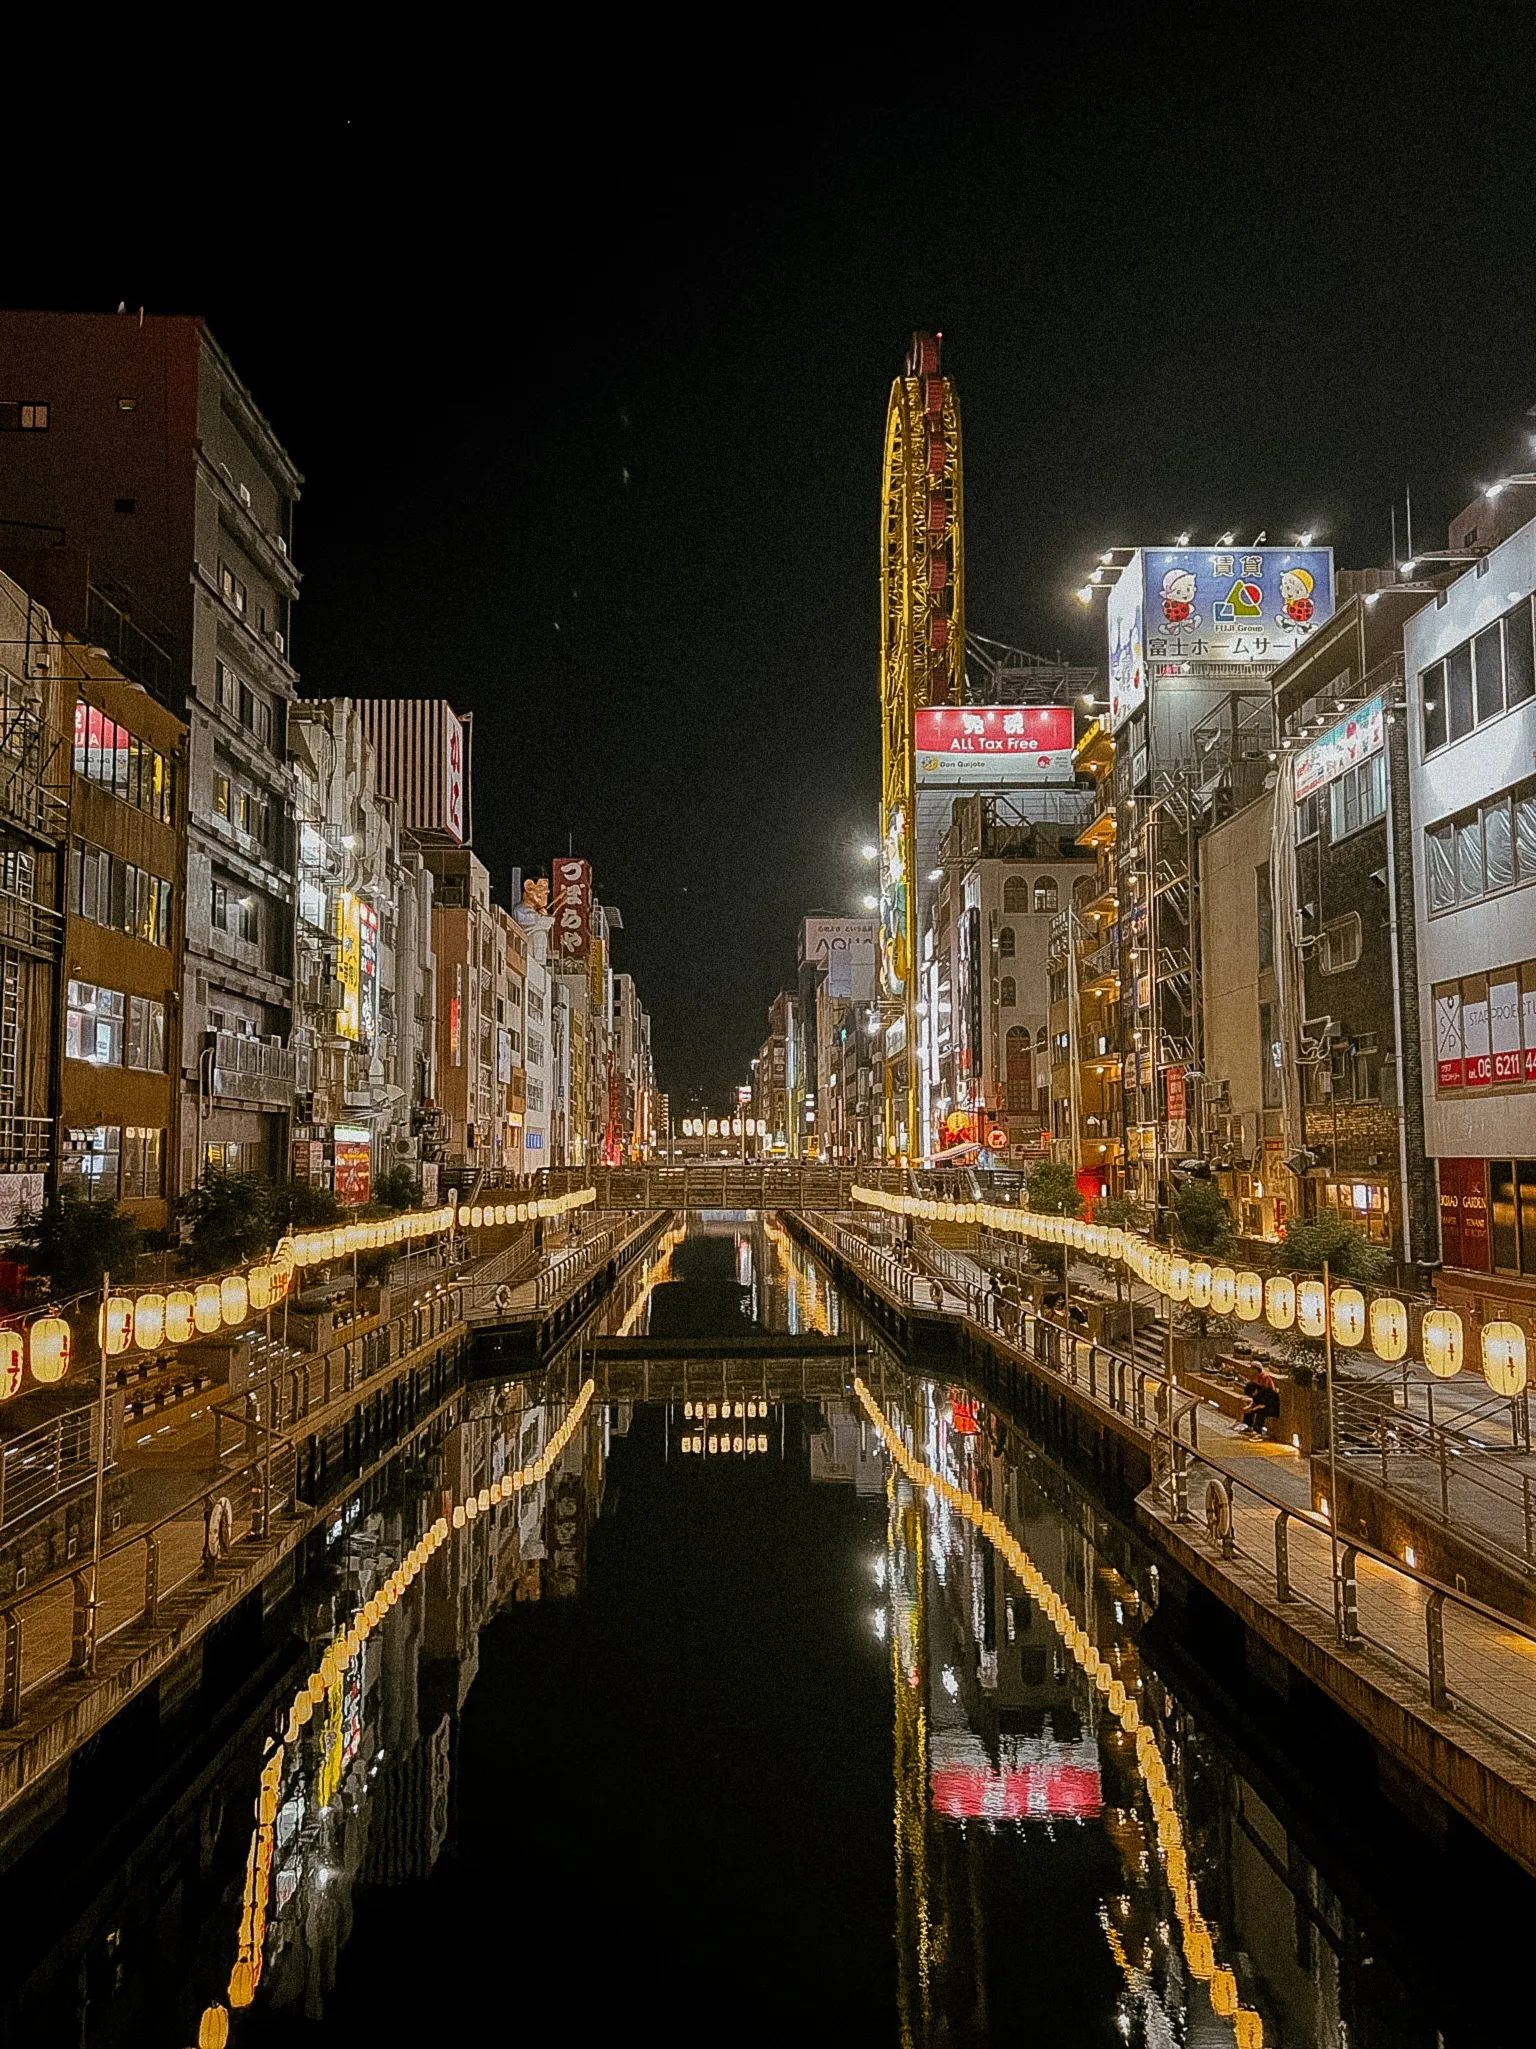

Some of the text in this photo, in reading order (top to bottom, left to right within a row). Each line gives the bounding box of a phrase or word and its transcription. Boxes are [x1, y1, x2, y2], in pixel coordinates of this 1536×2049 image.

[1213, 555, 1263, 578] 賃貸
[1215, 624, 1263, 633] FUJI Group
[962, 712, 1024, 735] 免税
[950, 737, 1038, 750] ALL Tax Free
[957, 760, 986, 769] Quijote
[1478, 1058, 1491, 1078] 06
[1495, 1054, 1520, 1076] 6211
